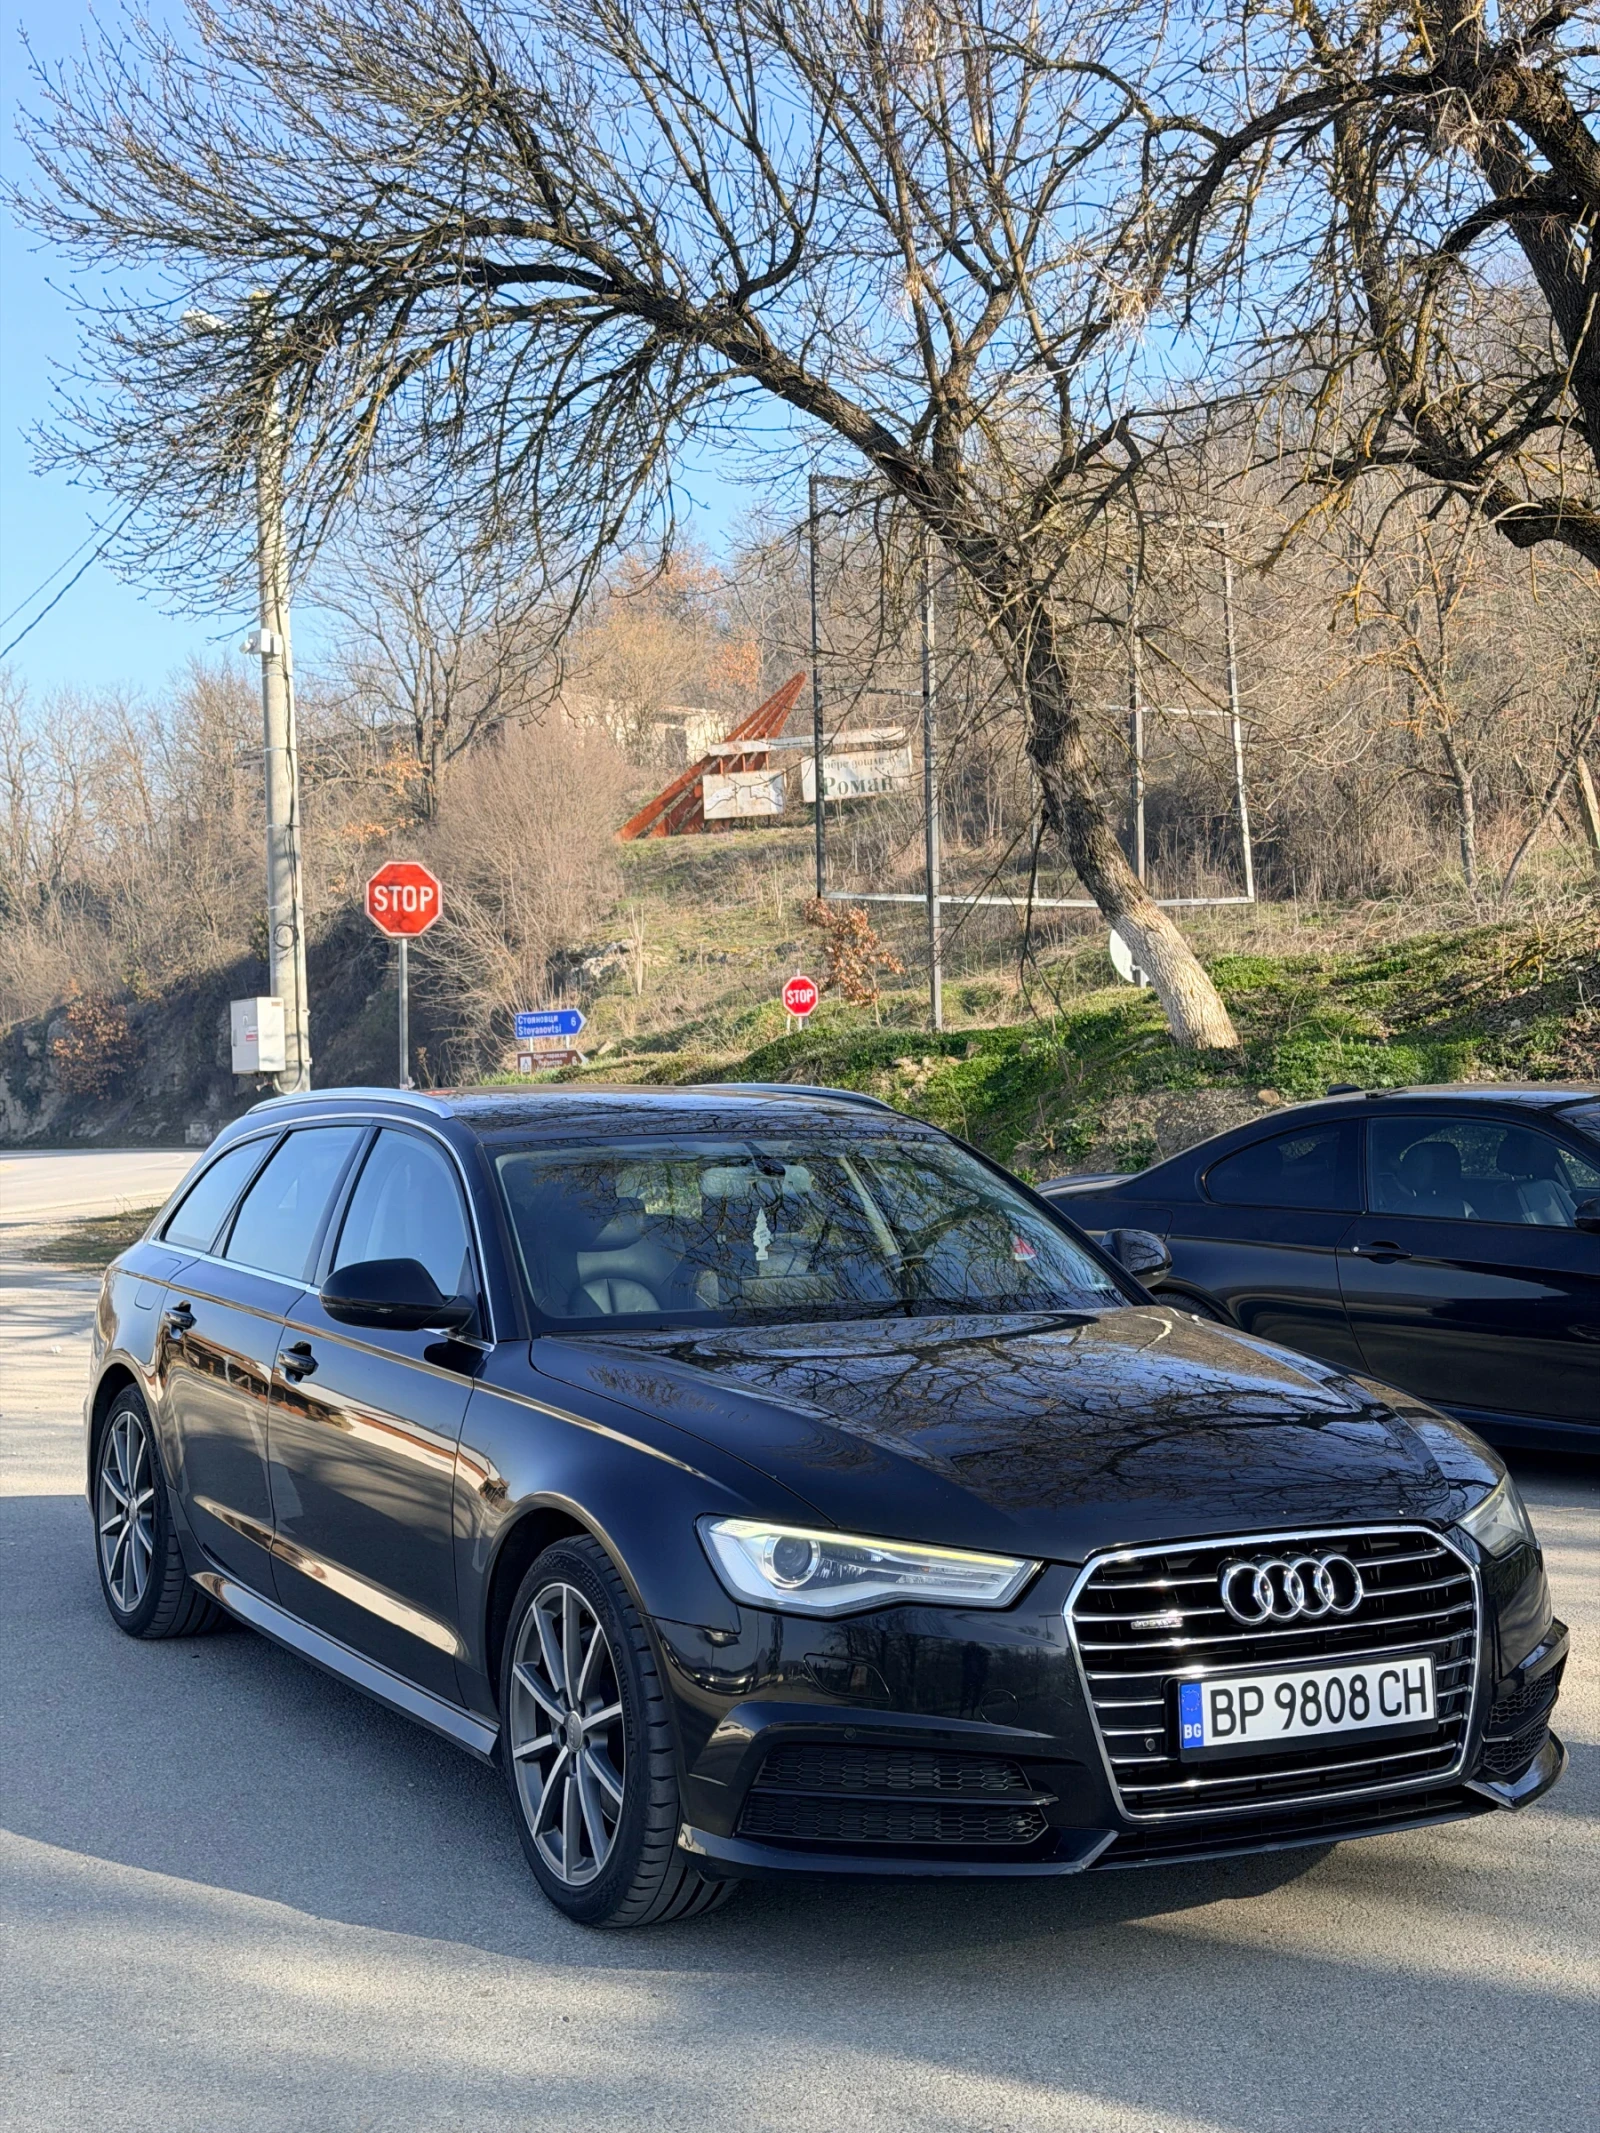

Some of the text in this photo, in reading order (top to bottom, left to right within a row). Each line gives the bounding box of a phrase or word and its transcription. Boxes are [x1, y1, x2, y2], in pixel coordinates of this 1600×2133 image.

[822, 759, 849, 772] обре
[823, 776, 894, 796] Роман
[373, 885, 434, 912] STOP
[787, 988, 814, 1005] STOP
[517, 1014, 559, 1026] Стояновци
[570, 1016, 577, 1027] 6
[518, 1023, 562, 1037] Stoyanovtsi
[571, 1056, 578, 1067] 6
[1210, 1665, 1428, 1738] BP 9808 CH
[1183, 1723, 1202, 1739] BG
